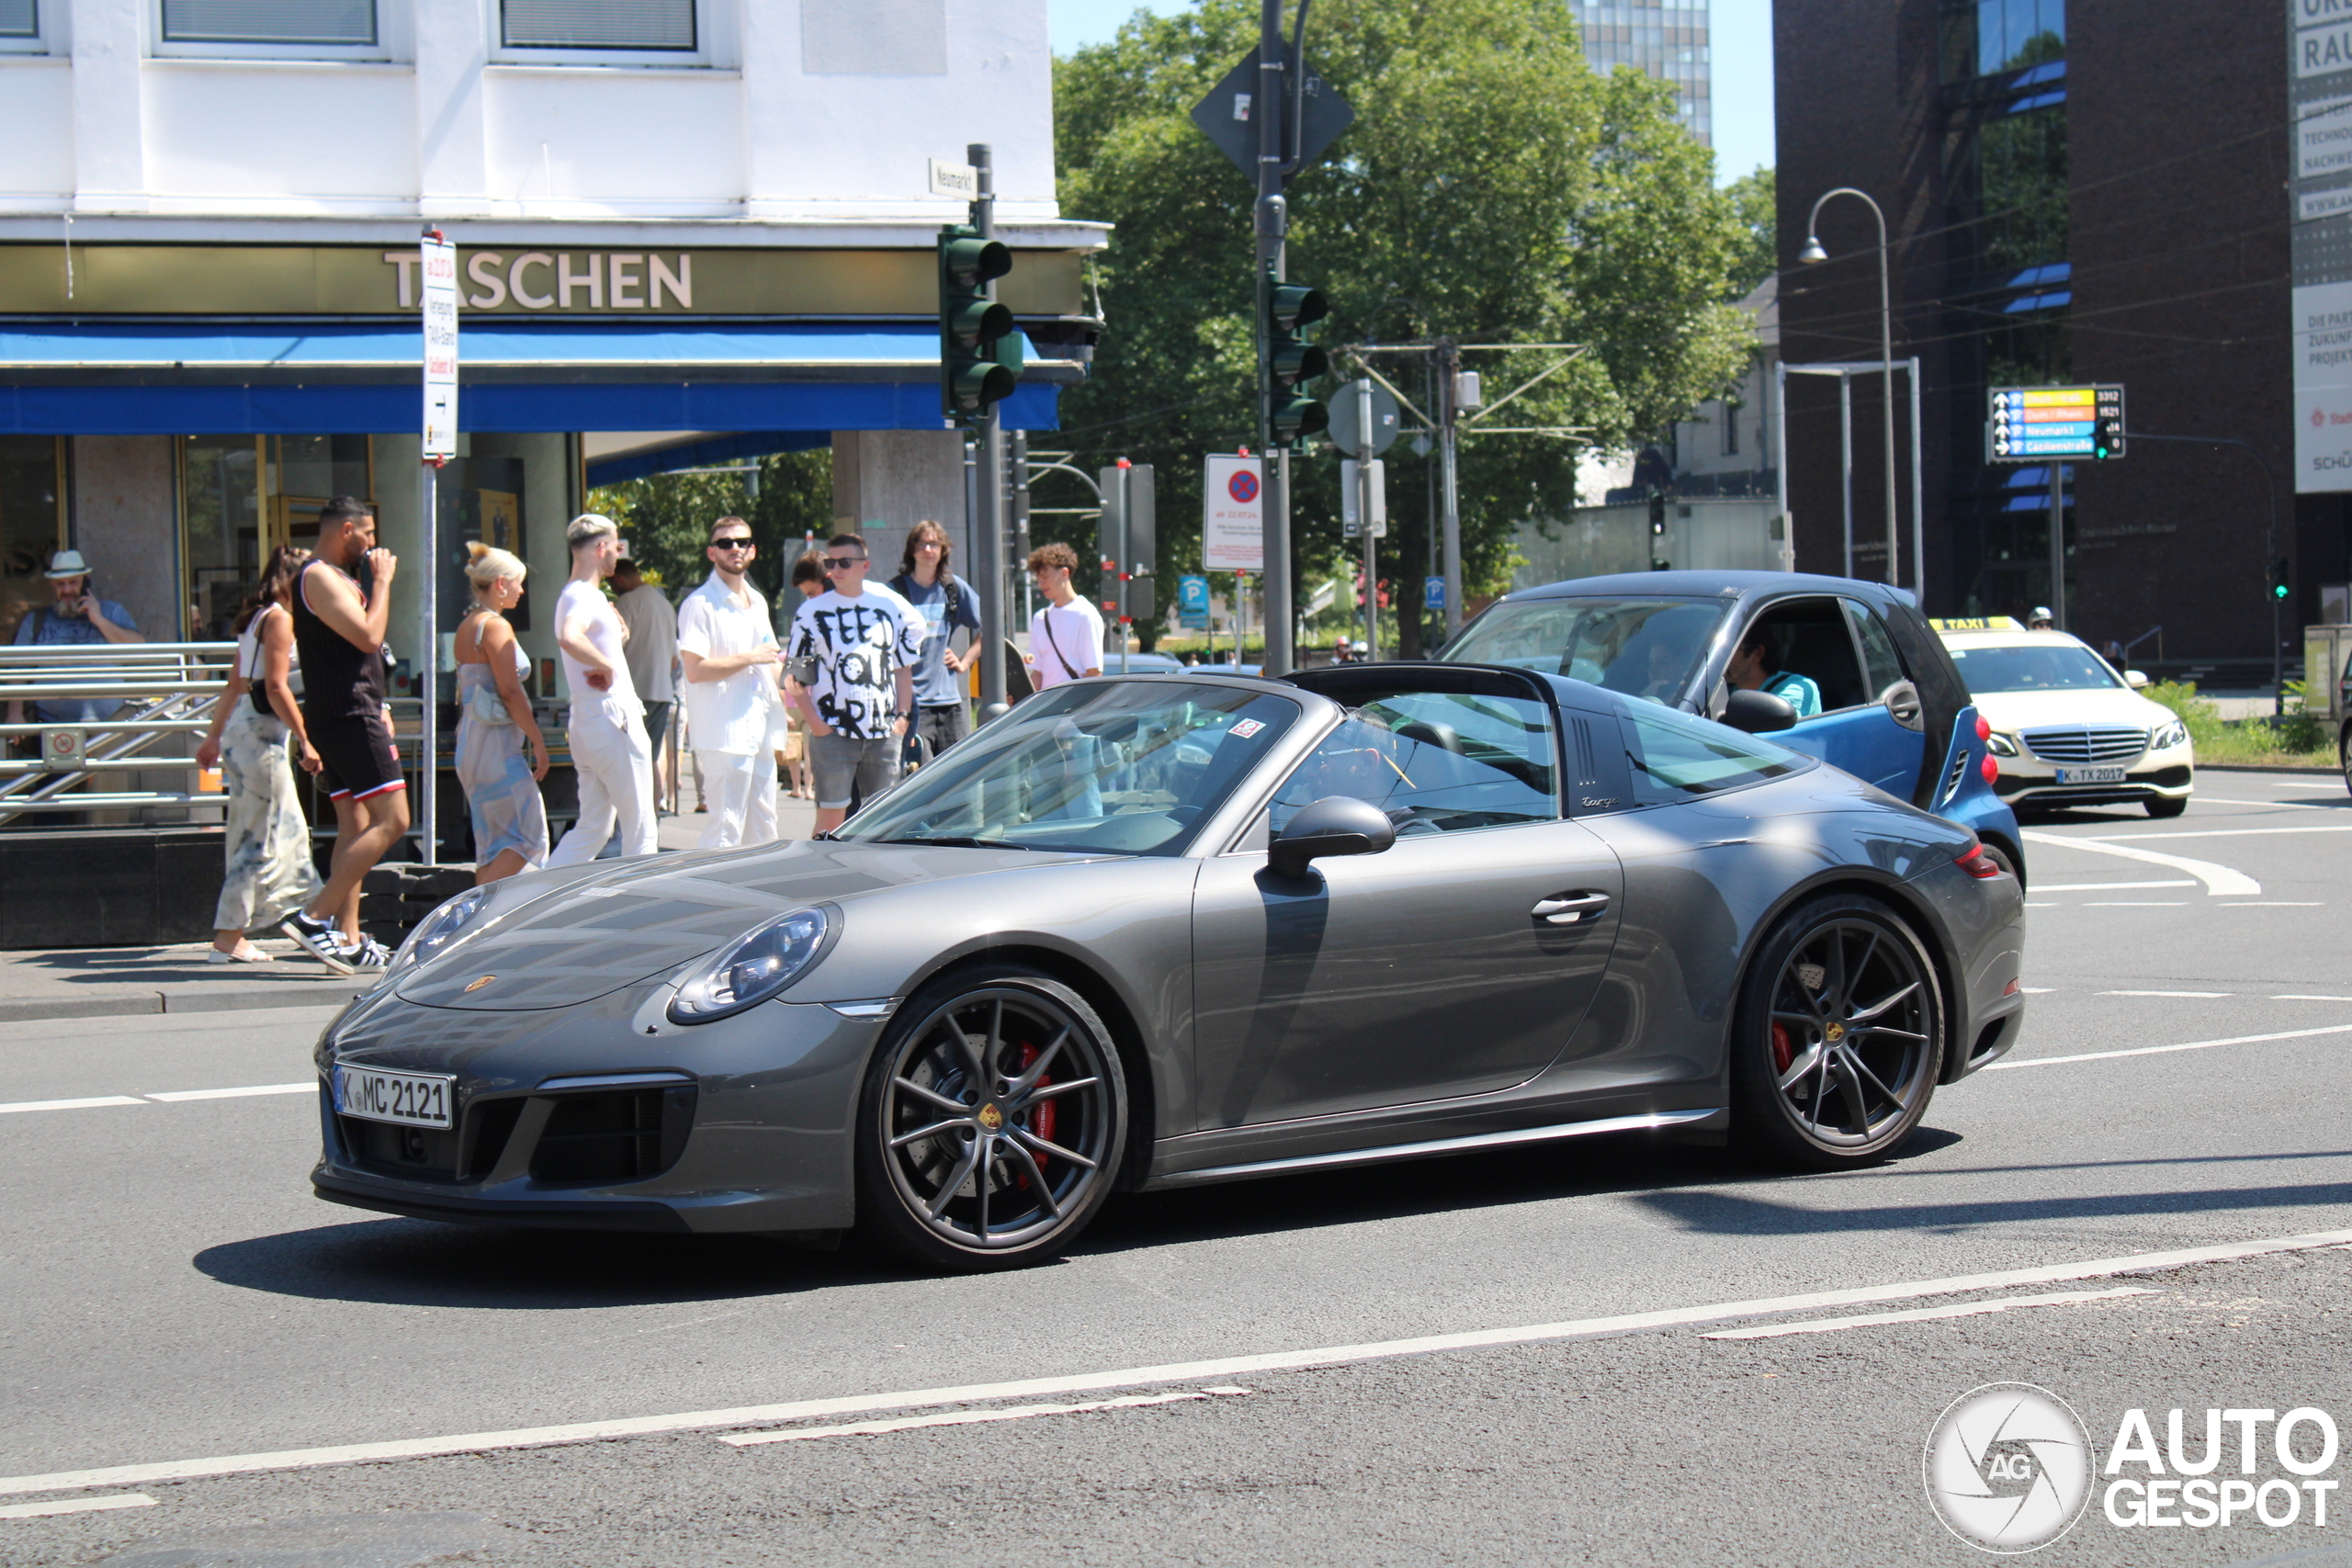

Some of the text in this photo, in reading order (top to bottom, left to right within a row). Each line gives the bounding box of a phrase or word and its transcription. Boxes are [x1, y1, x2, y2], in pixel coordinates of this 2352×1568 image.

[937, 164, 972, 191] Neumarkt
[2098, 390, 2120, 402] 3312
[2099, 406, 2120, 417] 1521
[2026, 424, 2075, 436] Neumarkt
[2026, 438, 2093, 452] Cäcilienstraße
[1187, 585, 1201, 601] P
[1431, 585, 1441, 597] P
[813, 604, 894, 656] FEED
[1946, 618, 1984, 630] TAXI
[2064, 768, 2123, 782] K TX 2017
[342, 1071, 447, 1122] K MC 2121
